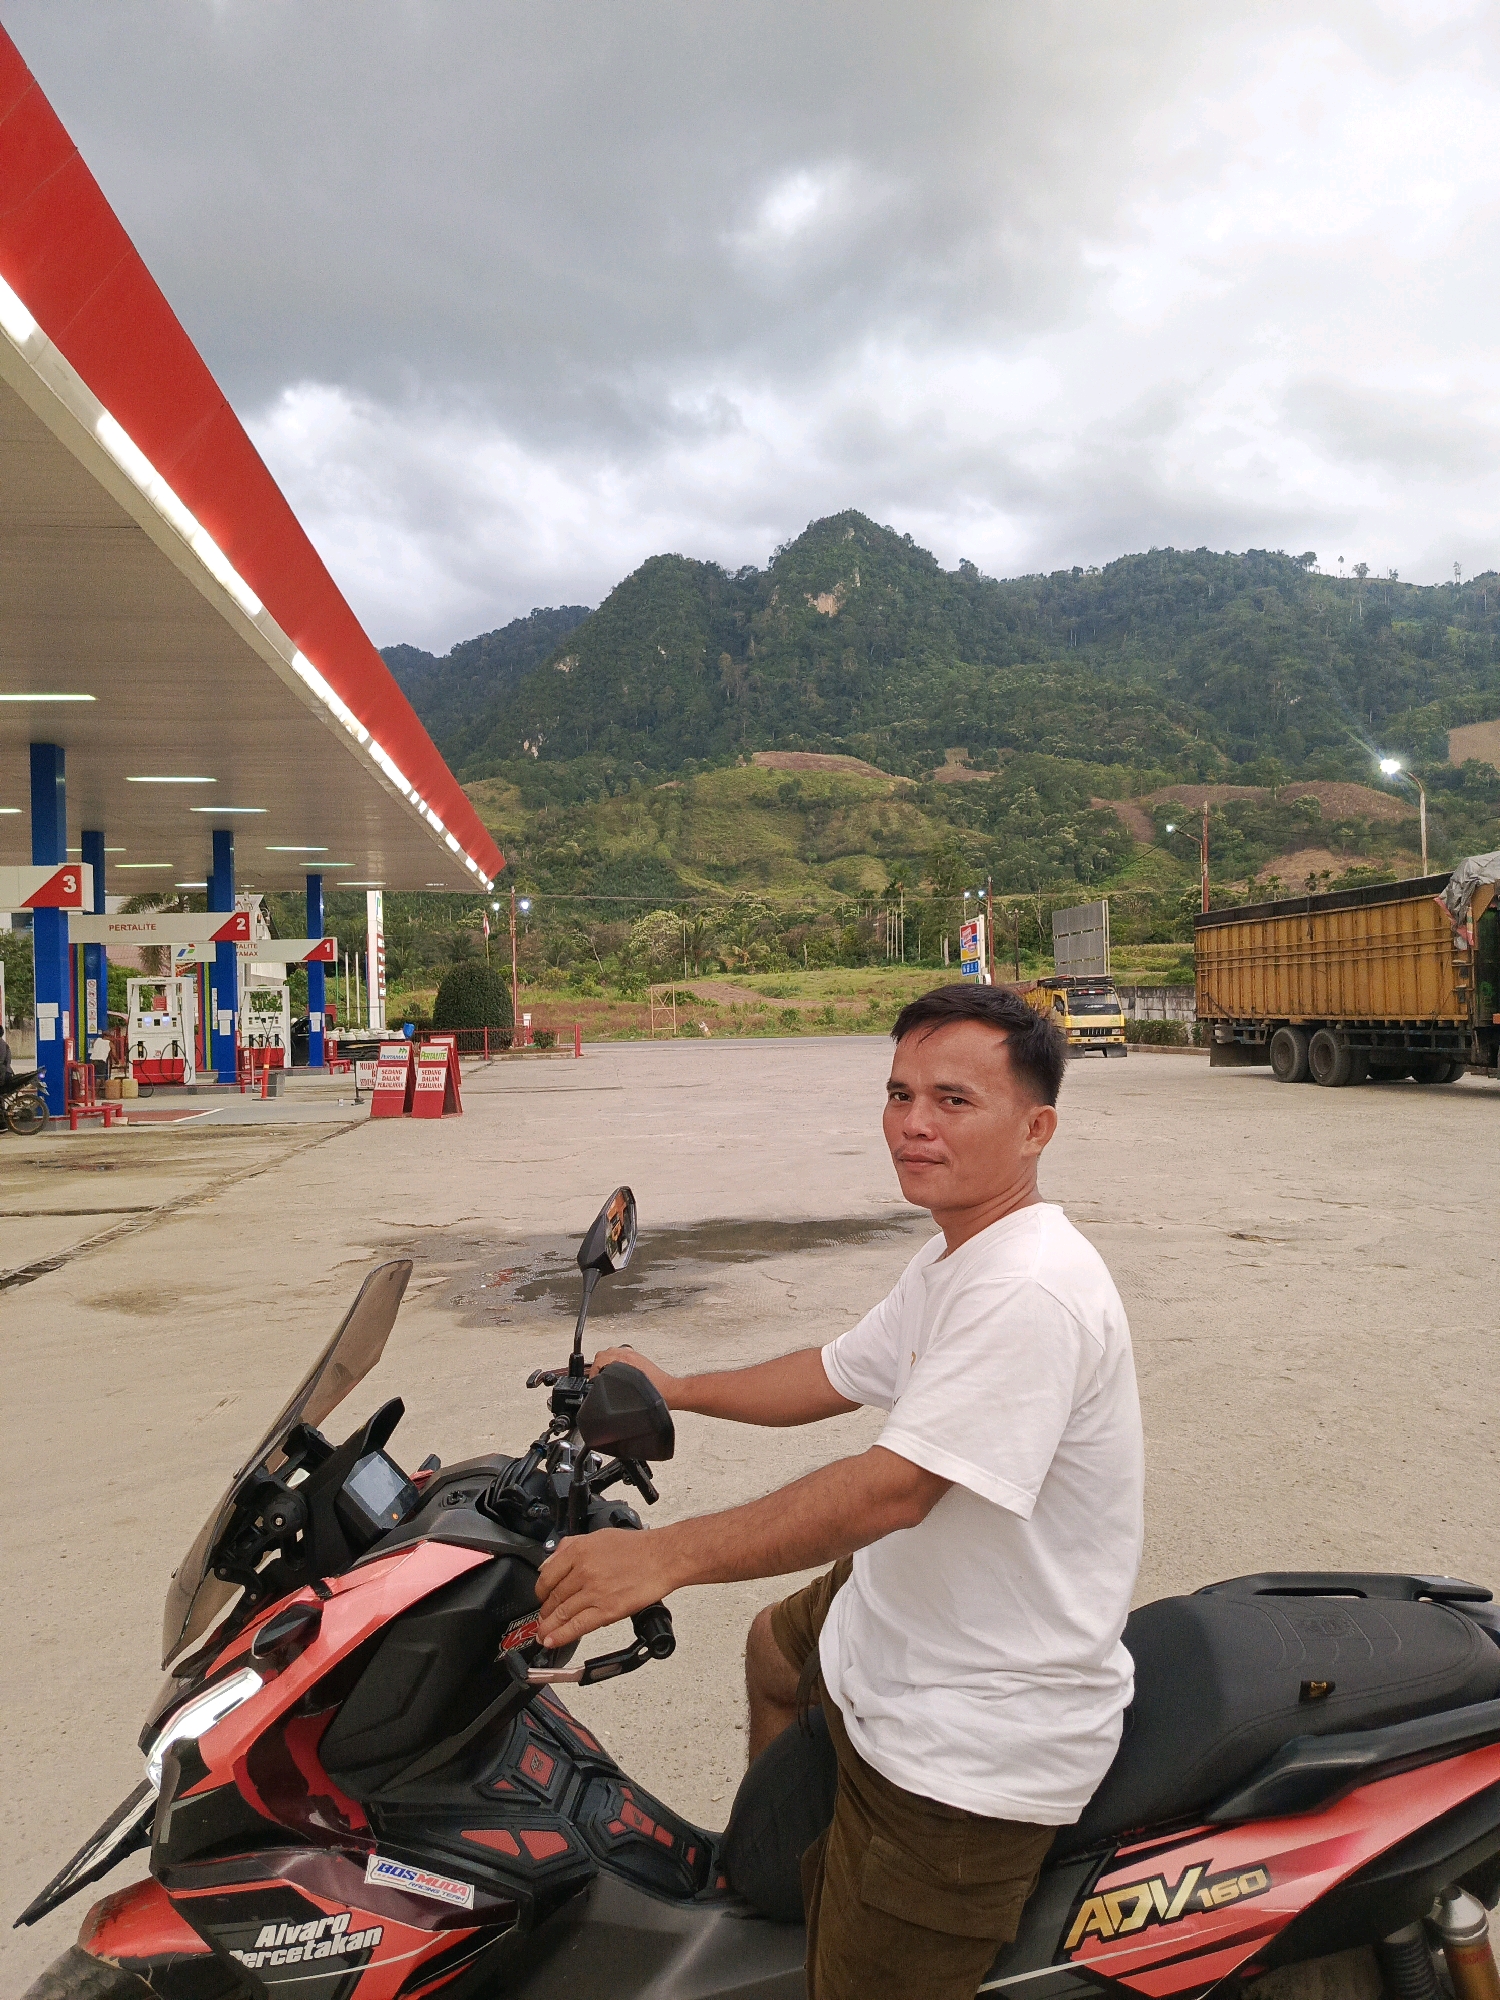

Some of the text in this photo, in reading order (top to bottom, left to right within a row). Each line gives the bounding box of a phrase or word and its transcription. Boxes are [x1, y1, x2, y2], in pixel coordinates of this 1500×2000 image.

[63, 875, 77, 893] 3
[108, 923, 157, 931] PERTALITE
[236, 918, 247, 930] 2
[324, 942, 330, 952] 1
[421, 1051, 447, 1060] PERTALITE
[408, 1881, 465, 1902] RACING TEAM
[1063, 1866, 1268, 1949] ADV 160
[254, 1913, 350, 1948] Alvaro
